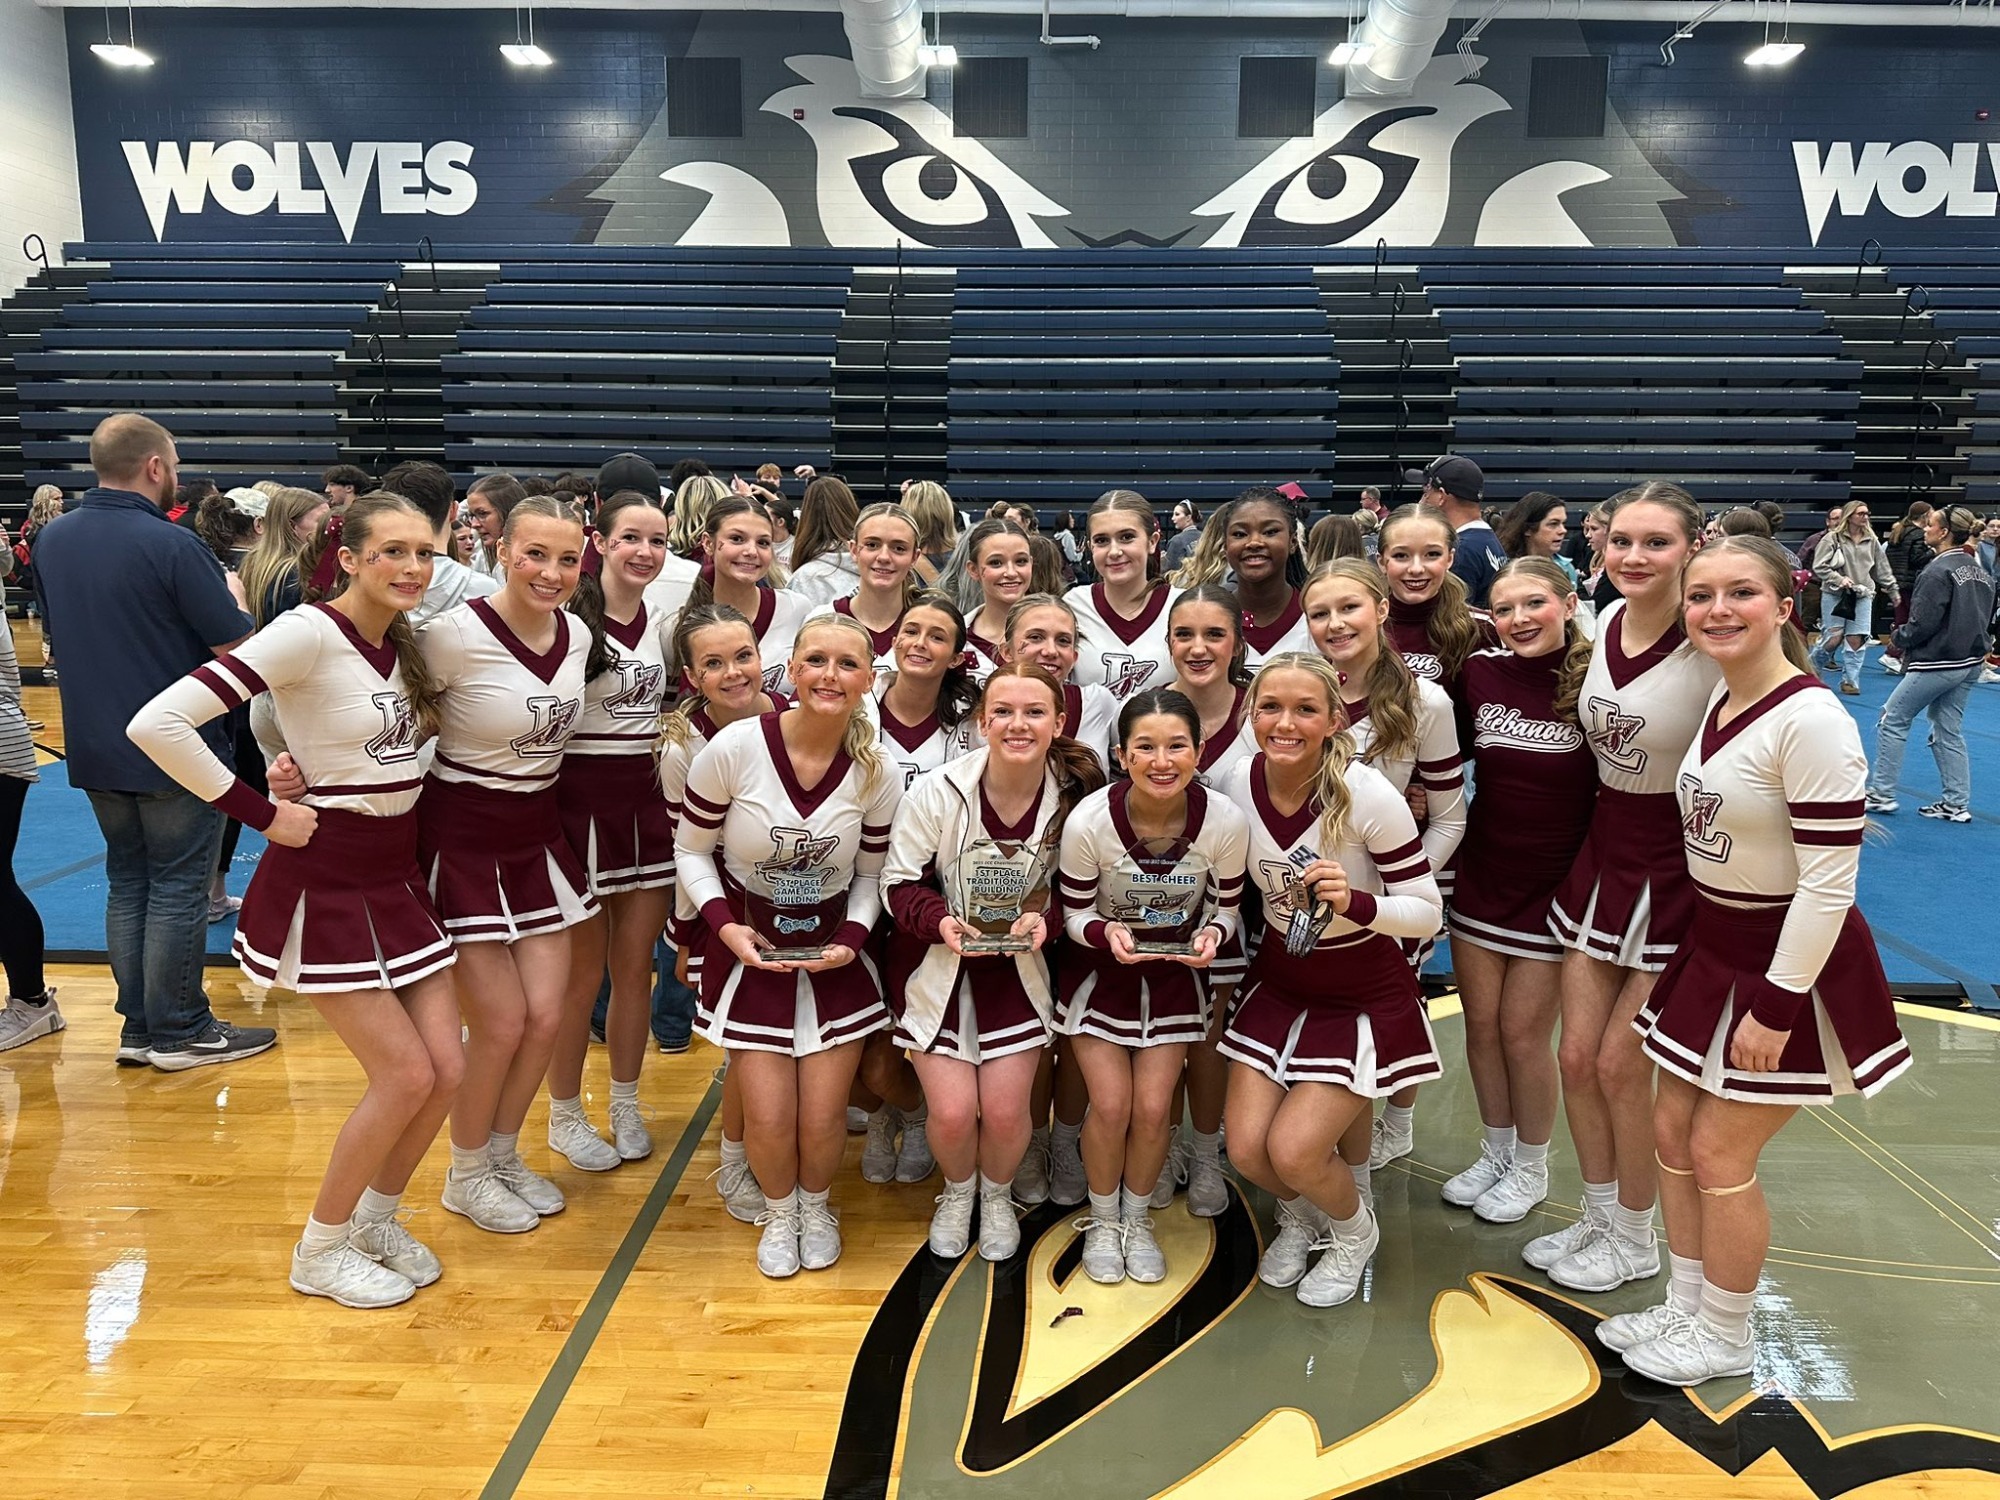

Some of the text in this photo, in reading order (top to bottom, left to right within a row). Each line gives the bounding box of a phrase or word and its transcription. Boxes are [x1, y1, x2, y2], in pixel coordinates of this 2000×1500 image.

[120, 139, 479, 245] WOLVES
[1791, 140, 2000, 248] WOL
[1475, 703, 1576, 743] Lebanon
[975, 869, 1022, 877] 1ST PLACE
[775, 879, 821, 887] 1ST PLACE
[966, 877, 1030, 885] TRADITIONAL
[1132, 873, 1197, 885] BEST CHEER
[773, 887, 821, 896] GAME DAY
[974, 886, 1022, 894] BUILDING
[774, 896, 820, 904] BUILDING
